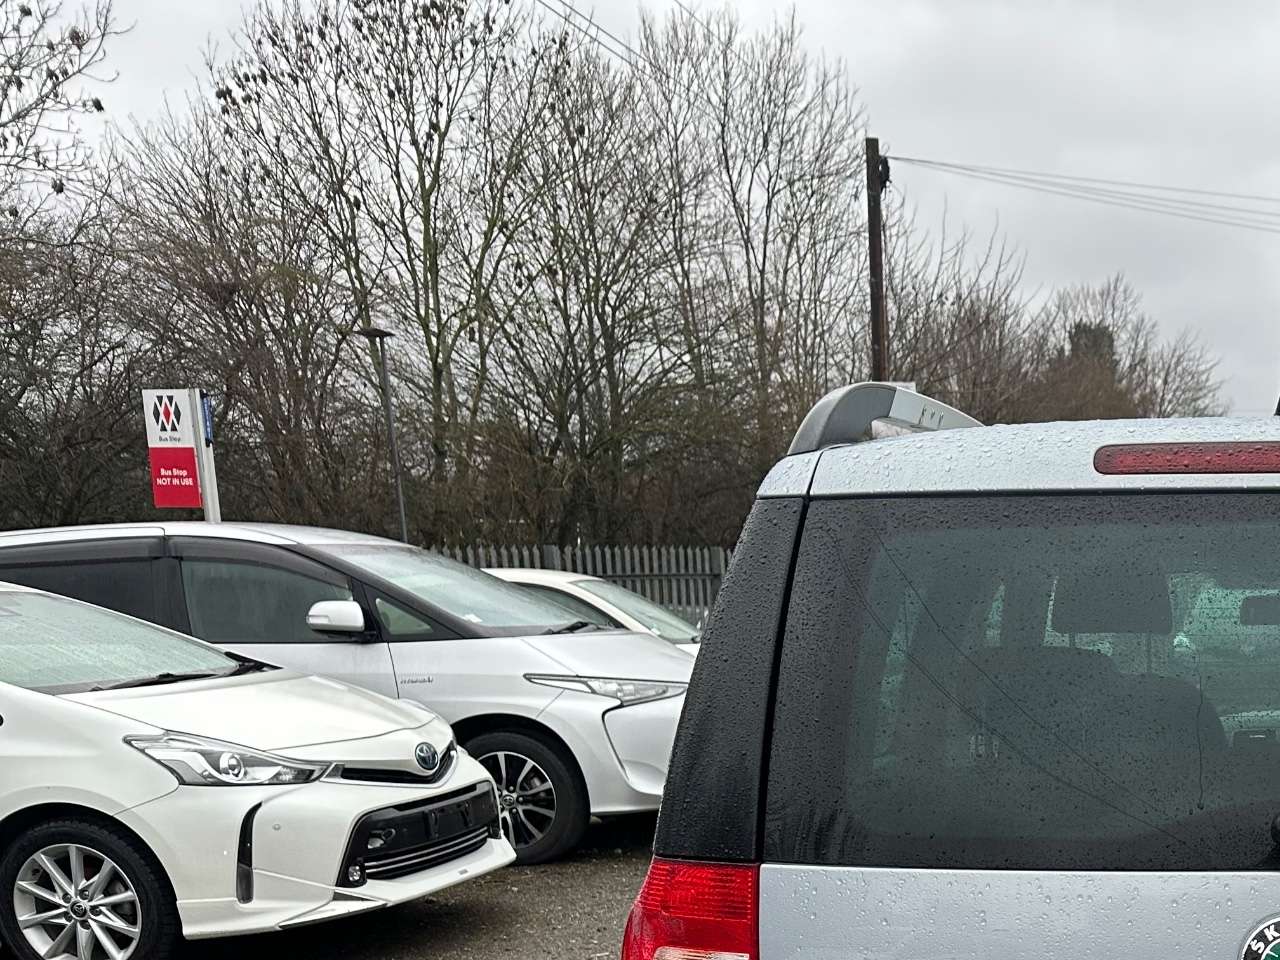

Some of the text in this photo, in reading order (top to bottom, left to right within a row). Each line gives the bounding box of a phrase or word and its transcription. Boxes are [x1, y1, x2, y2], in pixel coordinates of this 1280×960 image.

[169, 435, 181, 444] Stop
[160, 468, 188, 477] Bus Stop
[156, 478, 194, 486] NOT IN USE
